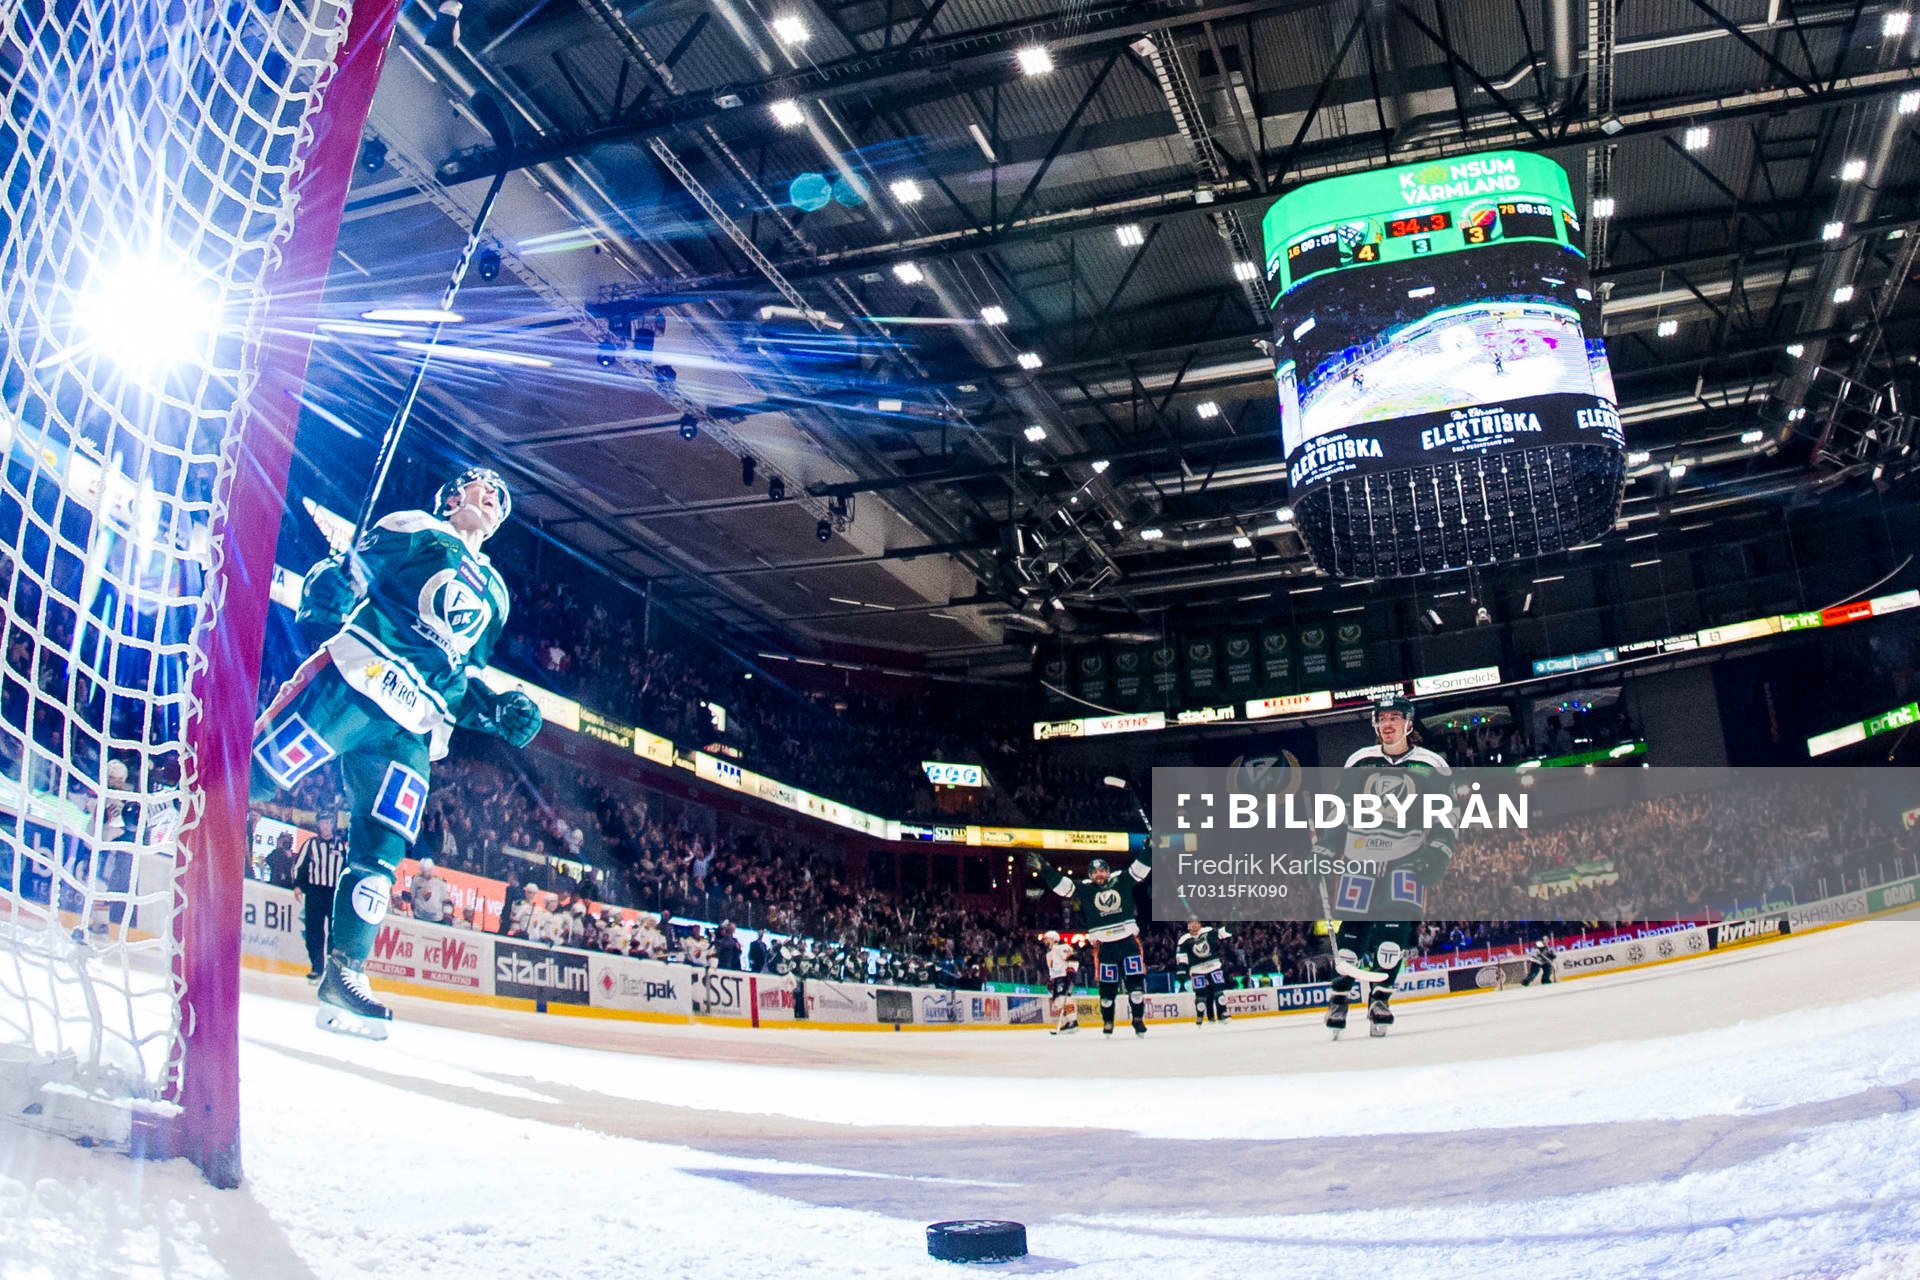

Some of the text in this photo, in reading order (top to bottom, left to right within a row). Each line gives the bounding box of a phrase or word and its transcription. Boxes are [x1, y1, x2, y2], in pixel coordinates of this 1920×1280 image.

[1401, 175, 1521, 205] VÄRMLAND
[1391, 213, 1447, 237] 34.3
[1469, 226, 1485, 243] 3
[1358, 244, 1375, 261] 4
[1416, 239, 1428, 253] 3
[1420, 412, 1543, 451] ELEKTRISKA
[1290, 438, 1384, 488] ELEKTRISKA
[1432, 672, 1498, 690] Sonnelids
[1177, 705, 1235, 725] stadium
[1870, 707, 1912, 736] print
[265, 900, 292, 933] Bil
[496, 951, 589, 992] stadium
[1563, 953, 1616, 969] ŠKODA
[972, 998, 1000, 1018] ELON
